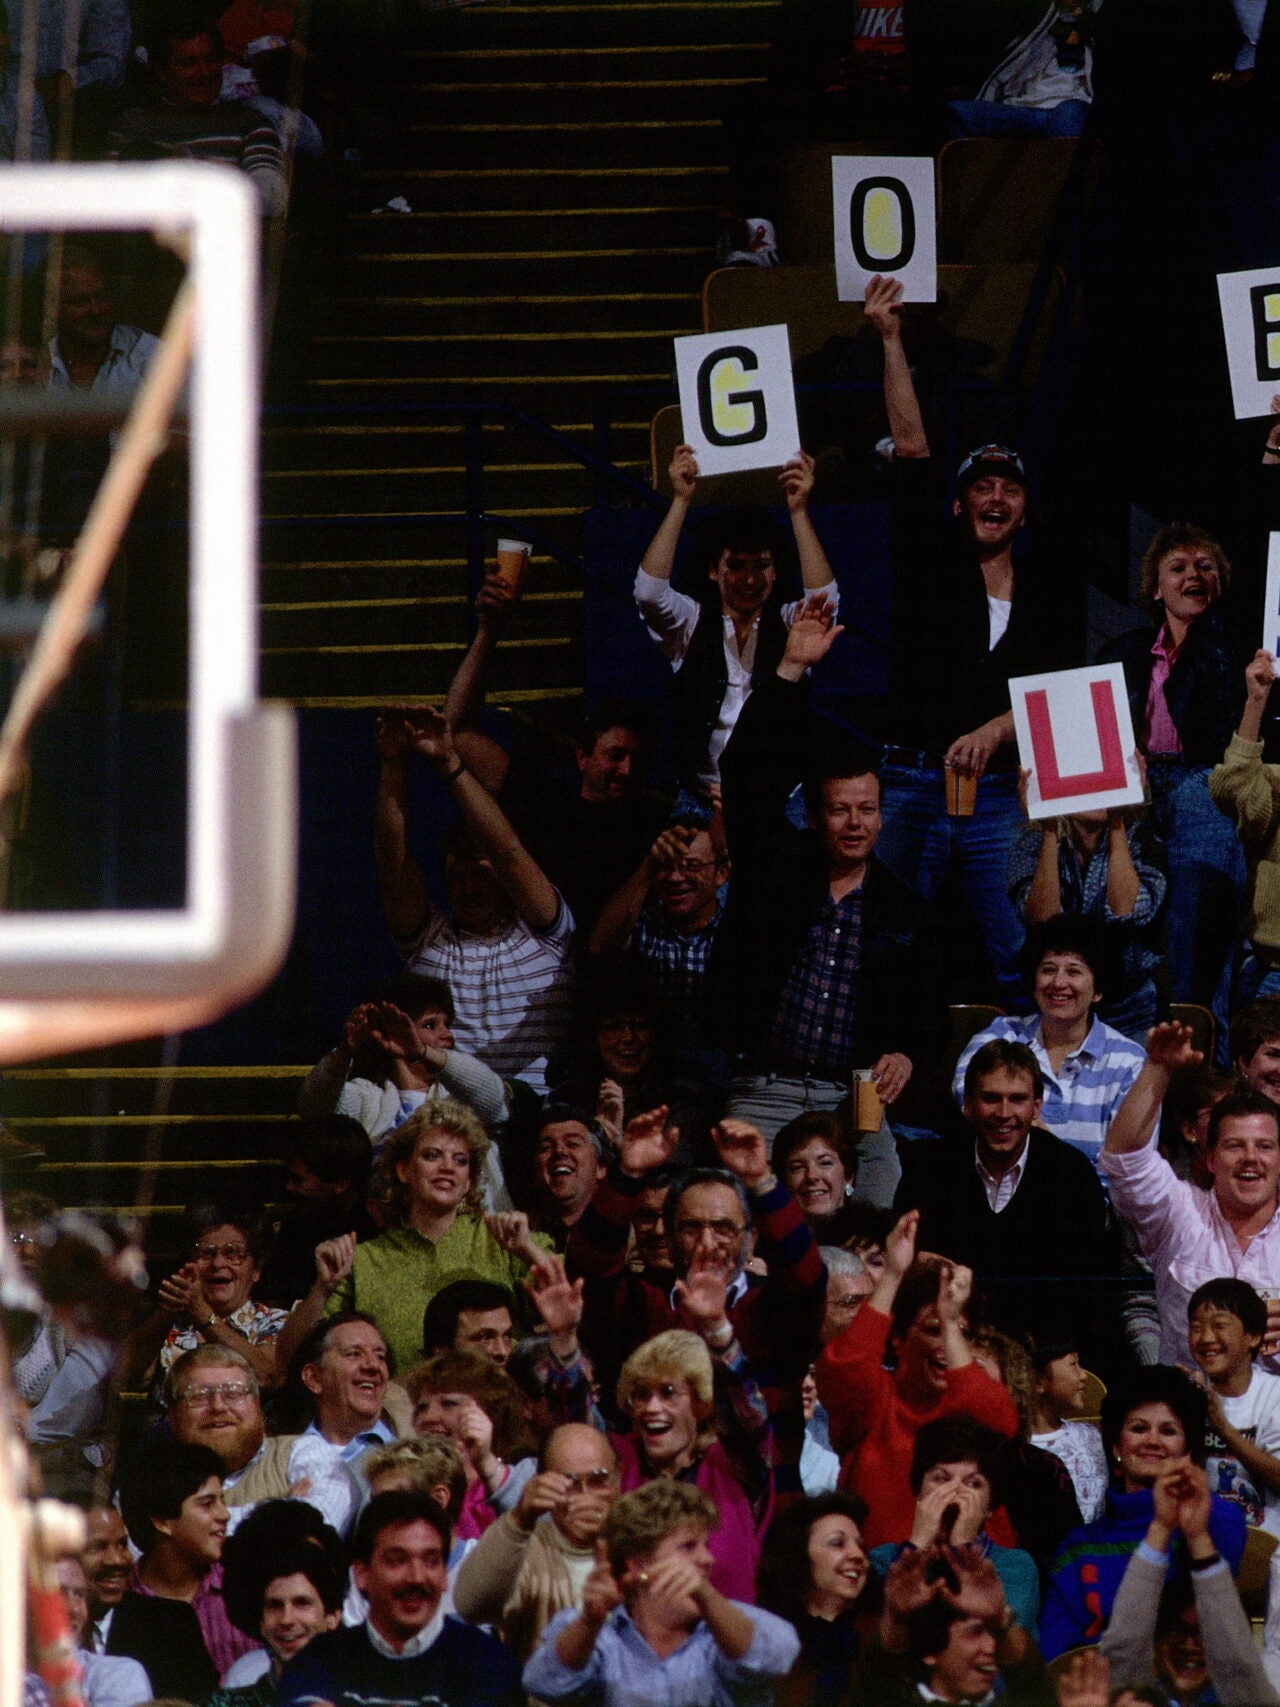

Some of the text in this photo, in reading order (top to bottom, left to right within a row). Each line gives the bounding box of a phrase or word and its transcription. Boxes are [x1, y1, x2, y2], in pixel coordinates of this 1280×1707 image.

[850, 176, 916, 272] O
[697, 345, 768, 446] G
[1025, 679, 1127, 801] U
